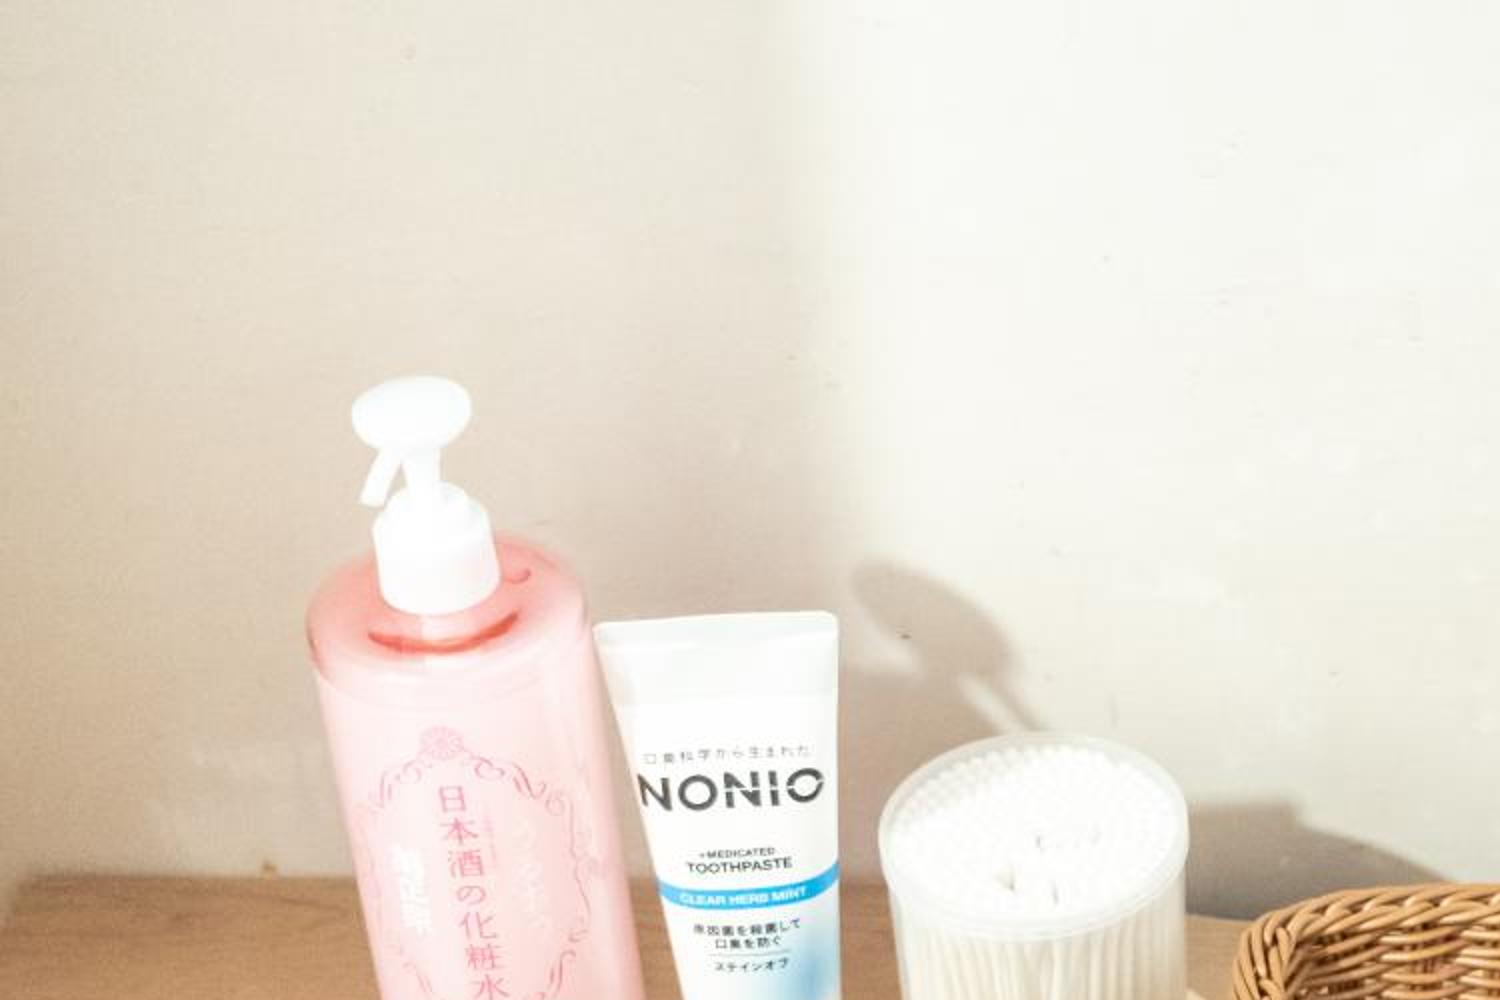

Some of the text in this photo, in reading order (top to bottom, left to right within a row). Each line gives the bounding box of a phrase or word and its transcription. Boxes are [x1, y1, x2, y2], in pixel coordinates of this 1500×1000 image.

[637, 768, 825, 811] NONIO
[687, 856, 793, 875] TOOTHPASTE
[679, 886, 807, 906] CLEAR HERB MINT
